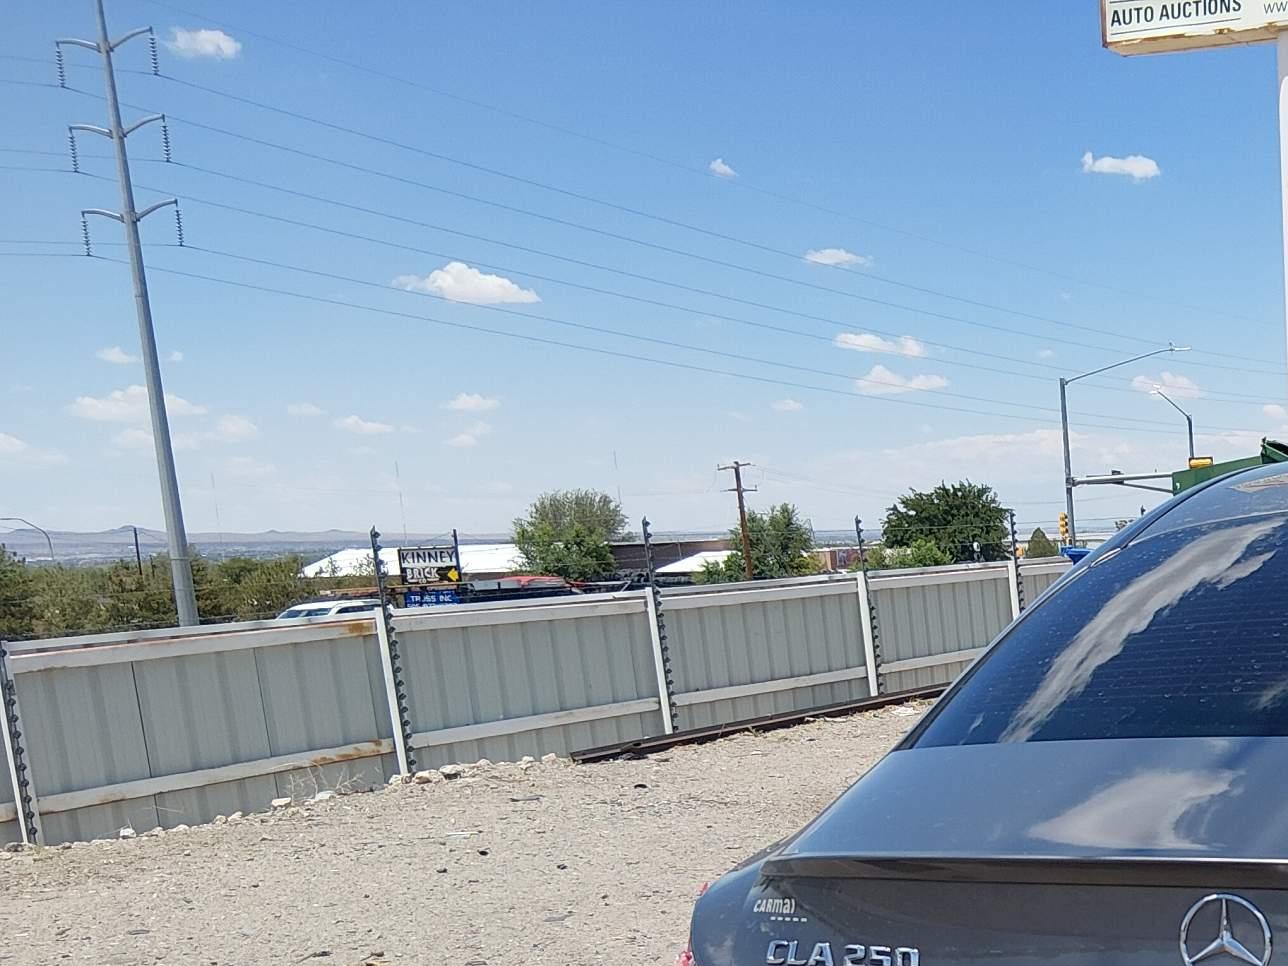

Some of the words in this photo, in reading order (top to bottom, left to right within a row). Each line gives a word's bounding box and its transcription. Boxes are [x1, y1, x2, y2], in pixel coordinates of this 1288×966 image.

[1111, 6, 1154, 27] AUTO
[1159, 0, 1242, 20] AUCTIONS
[401, 550, 455, 563] KINNEY
[406, 567, 440, 579] BRICK
